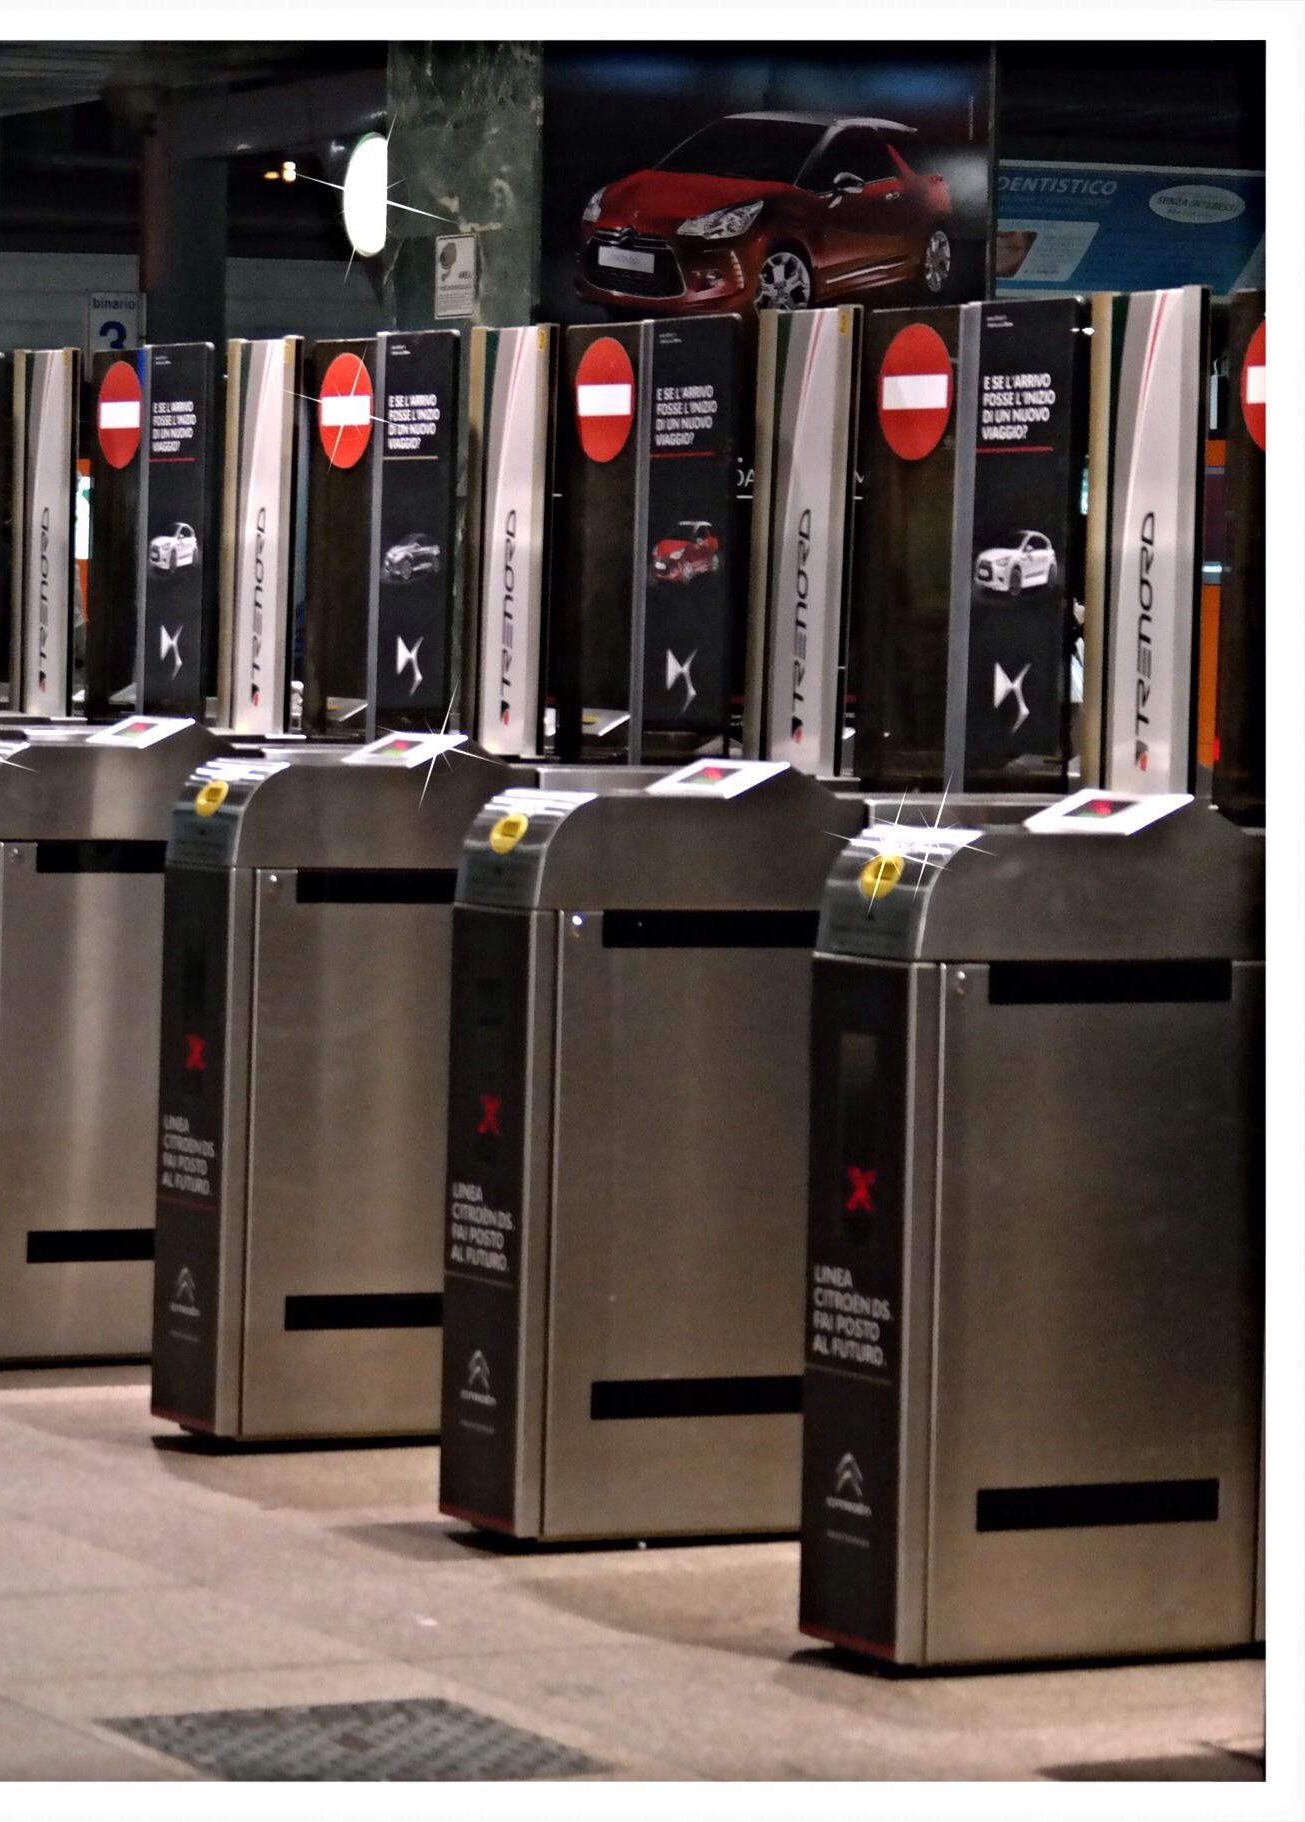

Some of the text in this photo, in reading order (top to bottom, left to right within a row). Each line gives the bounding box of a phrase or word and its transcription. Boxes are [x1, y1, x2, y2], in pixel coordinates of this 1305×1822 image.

[93, 297, 137, 310] binario
[983, 373, 1051, 390] E SE L'ARRIVO
[656, 388, 662, 401] E
[662, 387, 675, 400] SE
[982, 390, 1056, 407] FOSSE L'INIZIO
[655, 402, 683, 415] FOSSE
[982, 407, 1050, 424] DI UN NUOVO
[655, 417, 712, 431] DI UN NUOVO
[981, 426, 1028, 440] VIAGGIO?
[655, 433, 694, 446] VIAGGIO?
[501, 509, 517, 698] TRENORD
[792, 508, 812, 713] TRENORD
[1135, 511, 1156, 736] TRENORD
[452, 1182, 483, 1202] LINEA
[451, 1222, 504, 1250] FAI POSTO
[451, 1244, 464, 1263] AL
[814, 1264, 853, 1288] LINEA
[872, 1297, 894, 1322] DS.
[813, 1310, 881, 1342] FAI POSTO
[813, 1334, 888, 1367] AL FUTURO.
